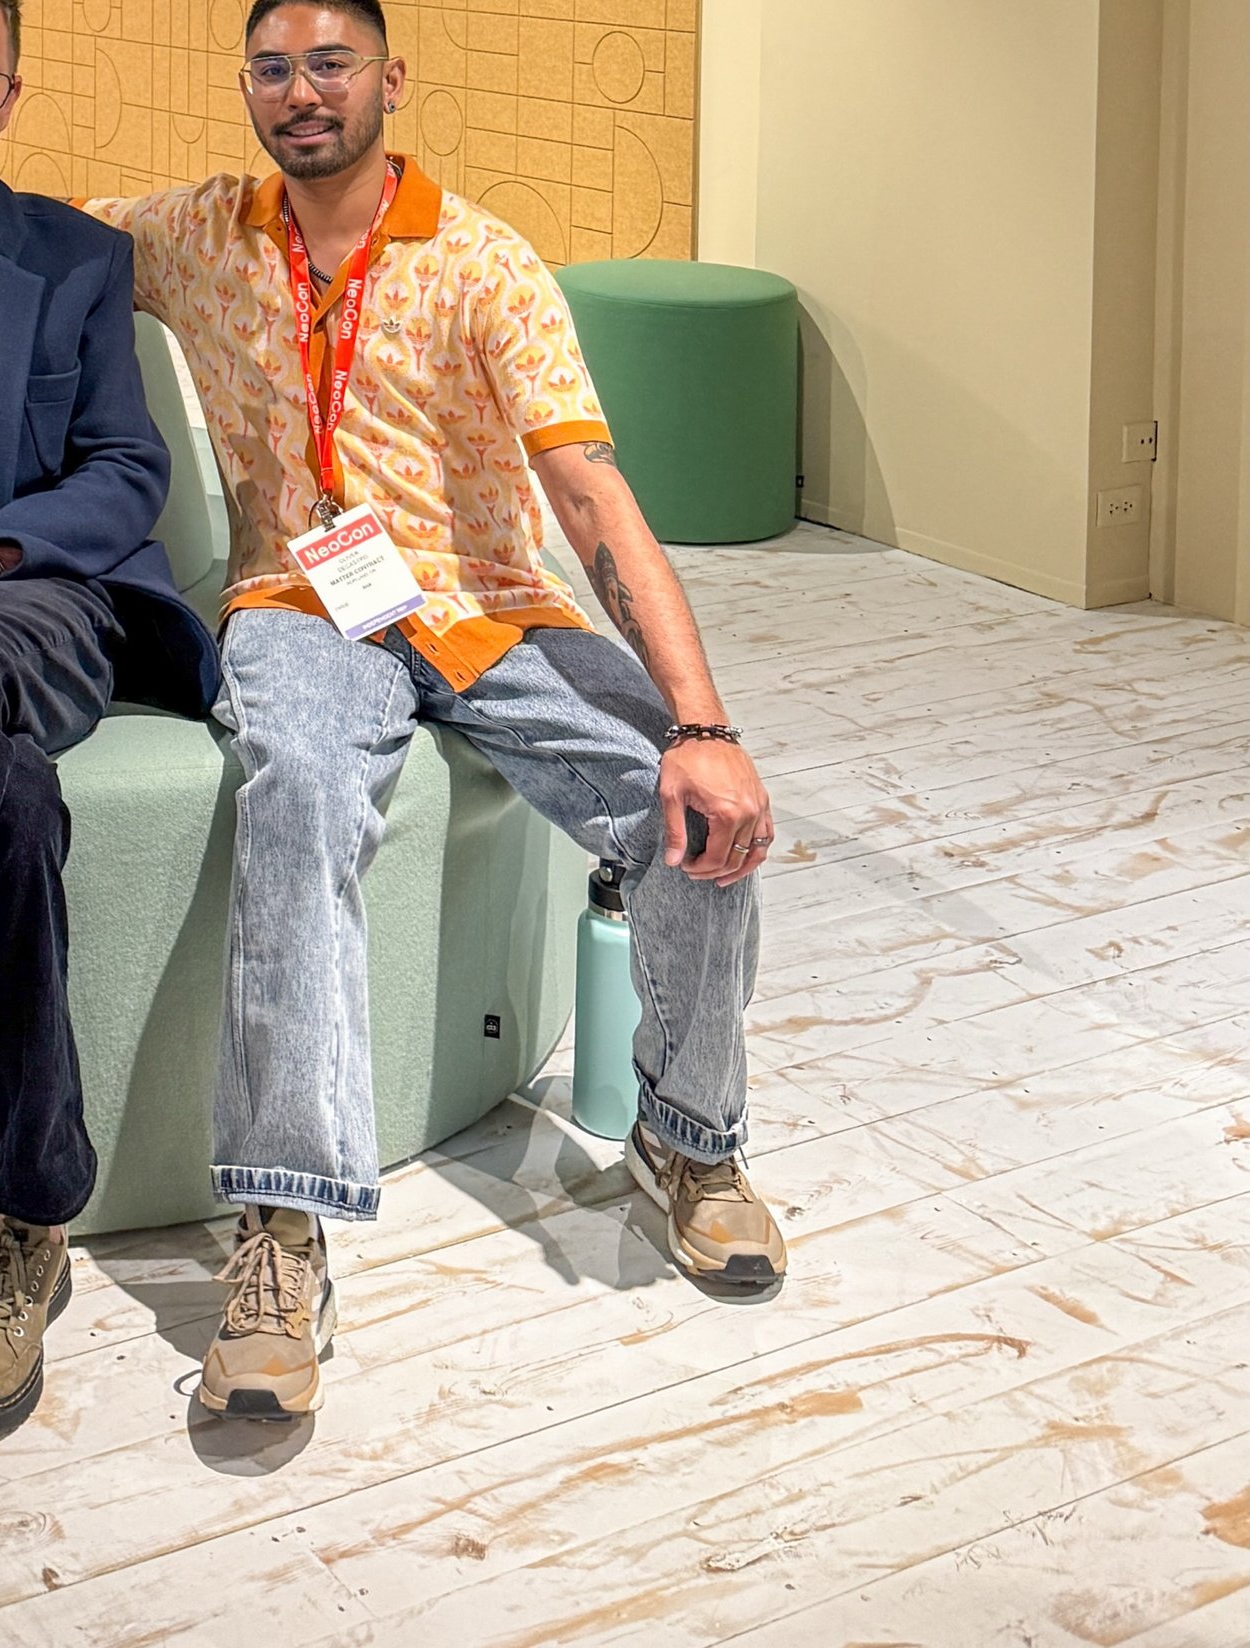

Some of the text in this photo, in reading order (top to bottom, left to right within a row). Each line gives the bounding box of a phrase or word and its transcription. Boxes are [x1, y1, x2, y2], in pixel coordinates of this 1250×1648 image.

[296, 283, 310, 343] NeoCon
[341, 279, 363, 340] NeoCon
[306, 373, 323, 434] NeoCon
[327, 370, 348, 431] NeoCon
[304, 522, 375, 564] NeoCon
[330, 571, 355, 587] MATTER
